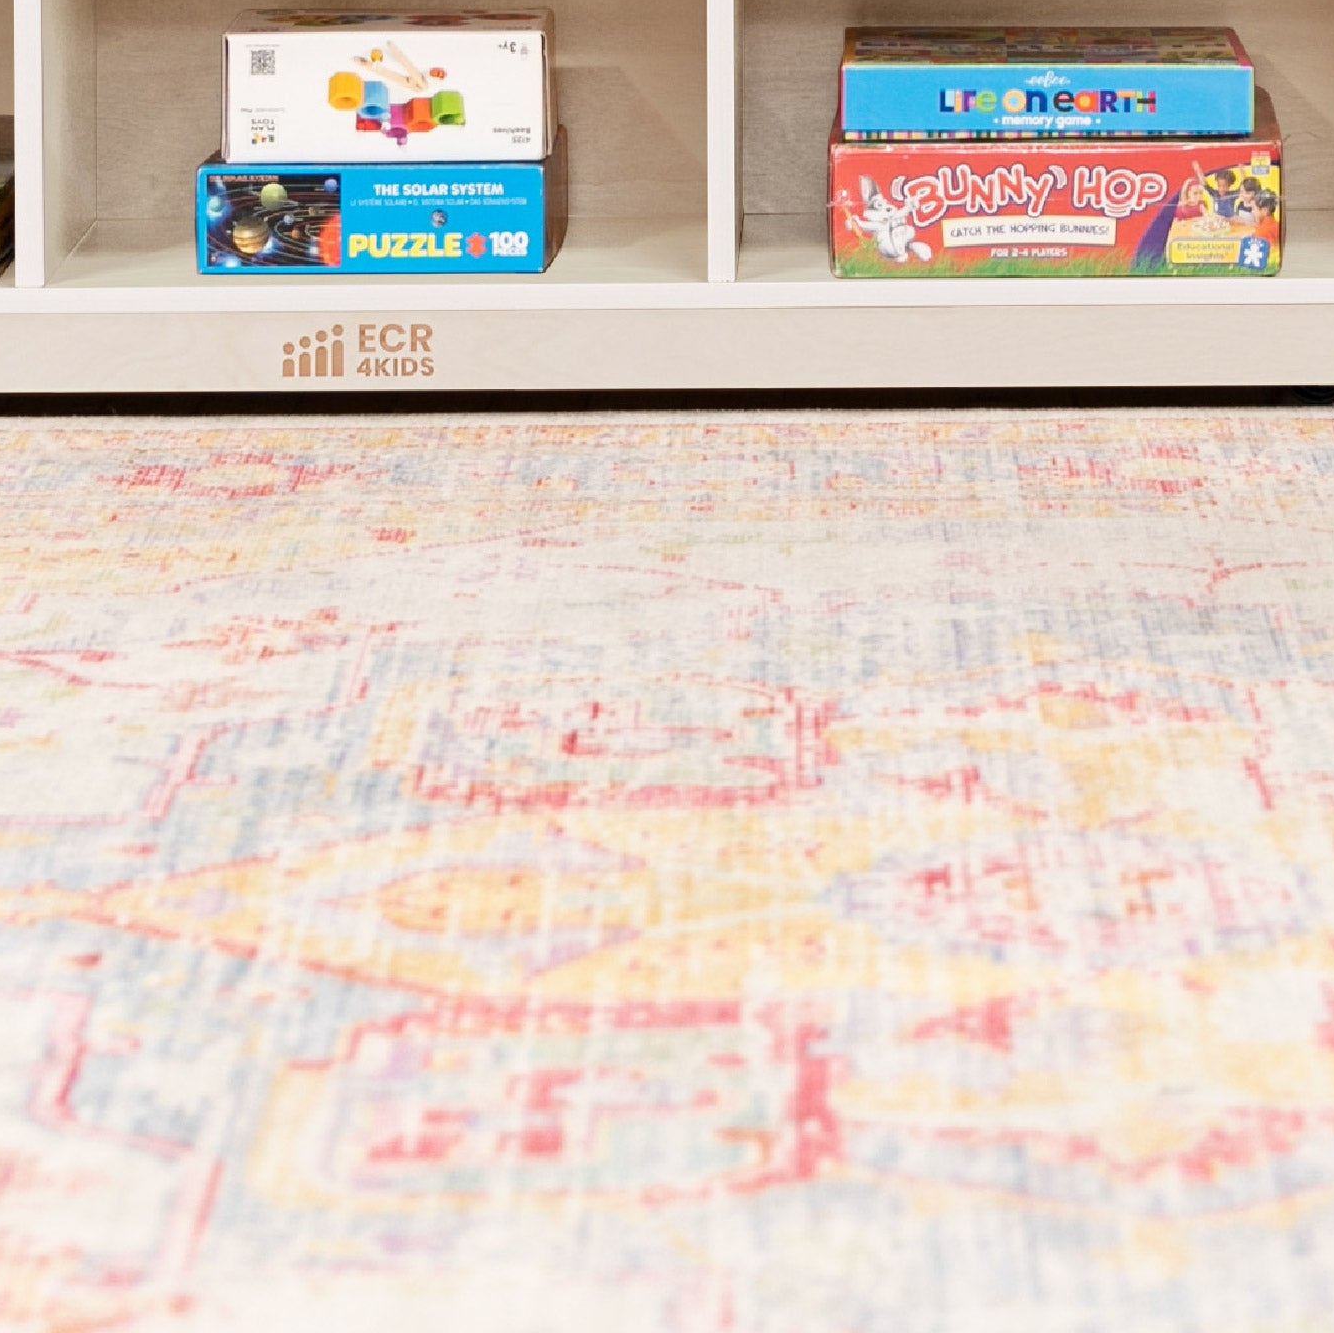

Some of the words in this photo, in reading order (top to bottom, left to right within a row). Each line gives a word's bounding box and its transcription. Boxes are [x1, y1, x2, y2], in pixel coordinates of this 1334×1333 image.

[1001, 115, 1053, 130] memory
[1055, 116, 1092, 130] game
[373, 183, 400, 196] THE
[402, 183, 449, 196] SOLAR
[450, 182, 505, 196] SYSTEM
[904, 163, 1055, 228] BUNNY
[1072, 164, 1168, 217] HOP
[951, 227, 981, 238] CATCH
[986, 225, 1004, 235] THE
[1010, 223, 1056, 234] HOPPING
[348, 232, 463, 258] PUZZLE
[489, 231, 529, 250] 100
[991, 247, 1008, 257] FOR
[1031, 247, 1068, 258] PLAYERS
[357, 323, 433, 352] ECR
[356, 356, 435, 377] 4KIDS
